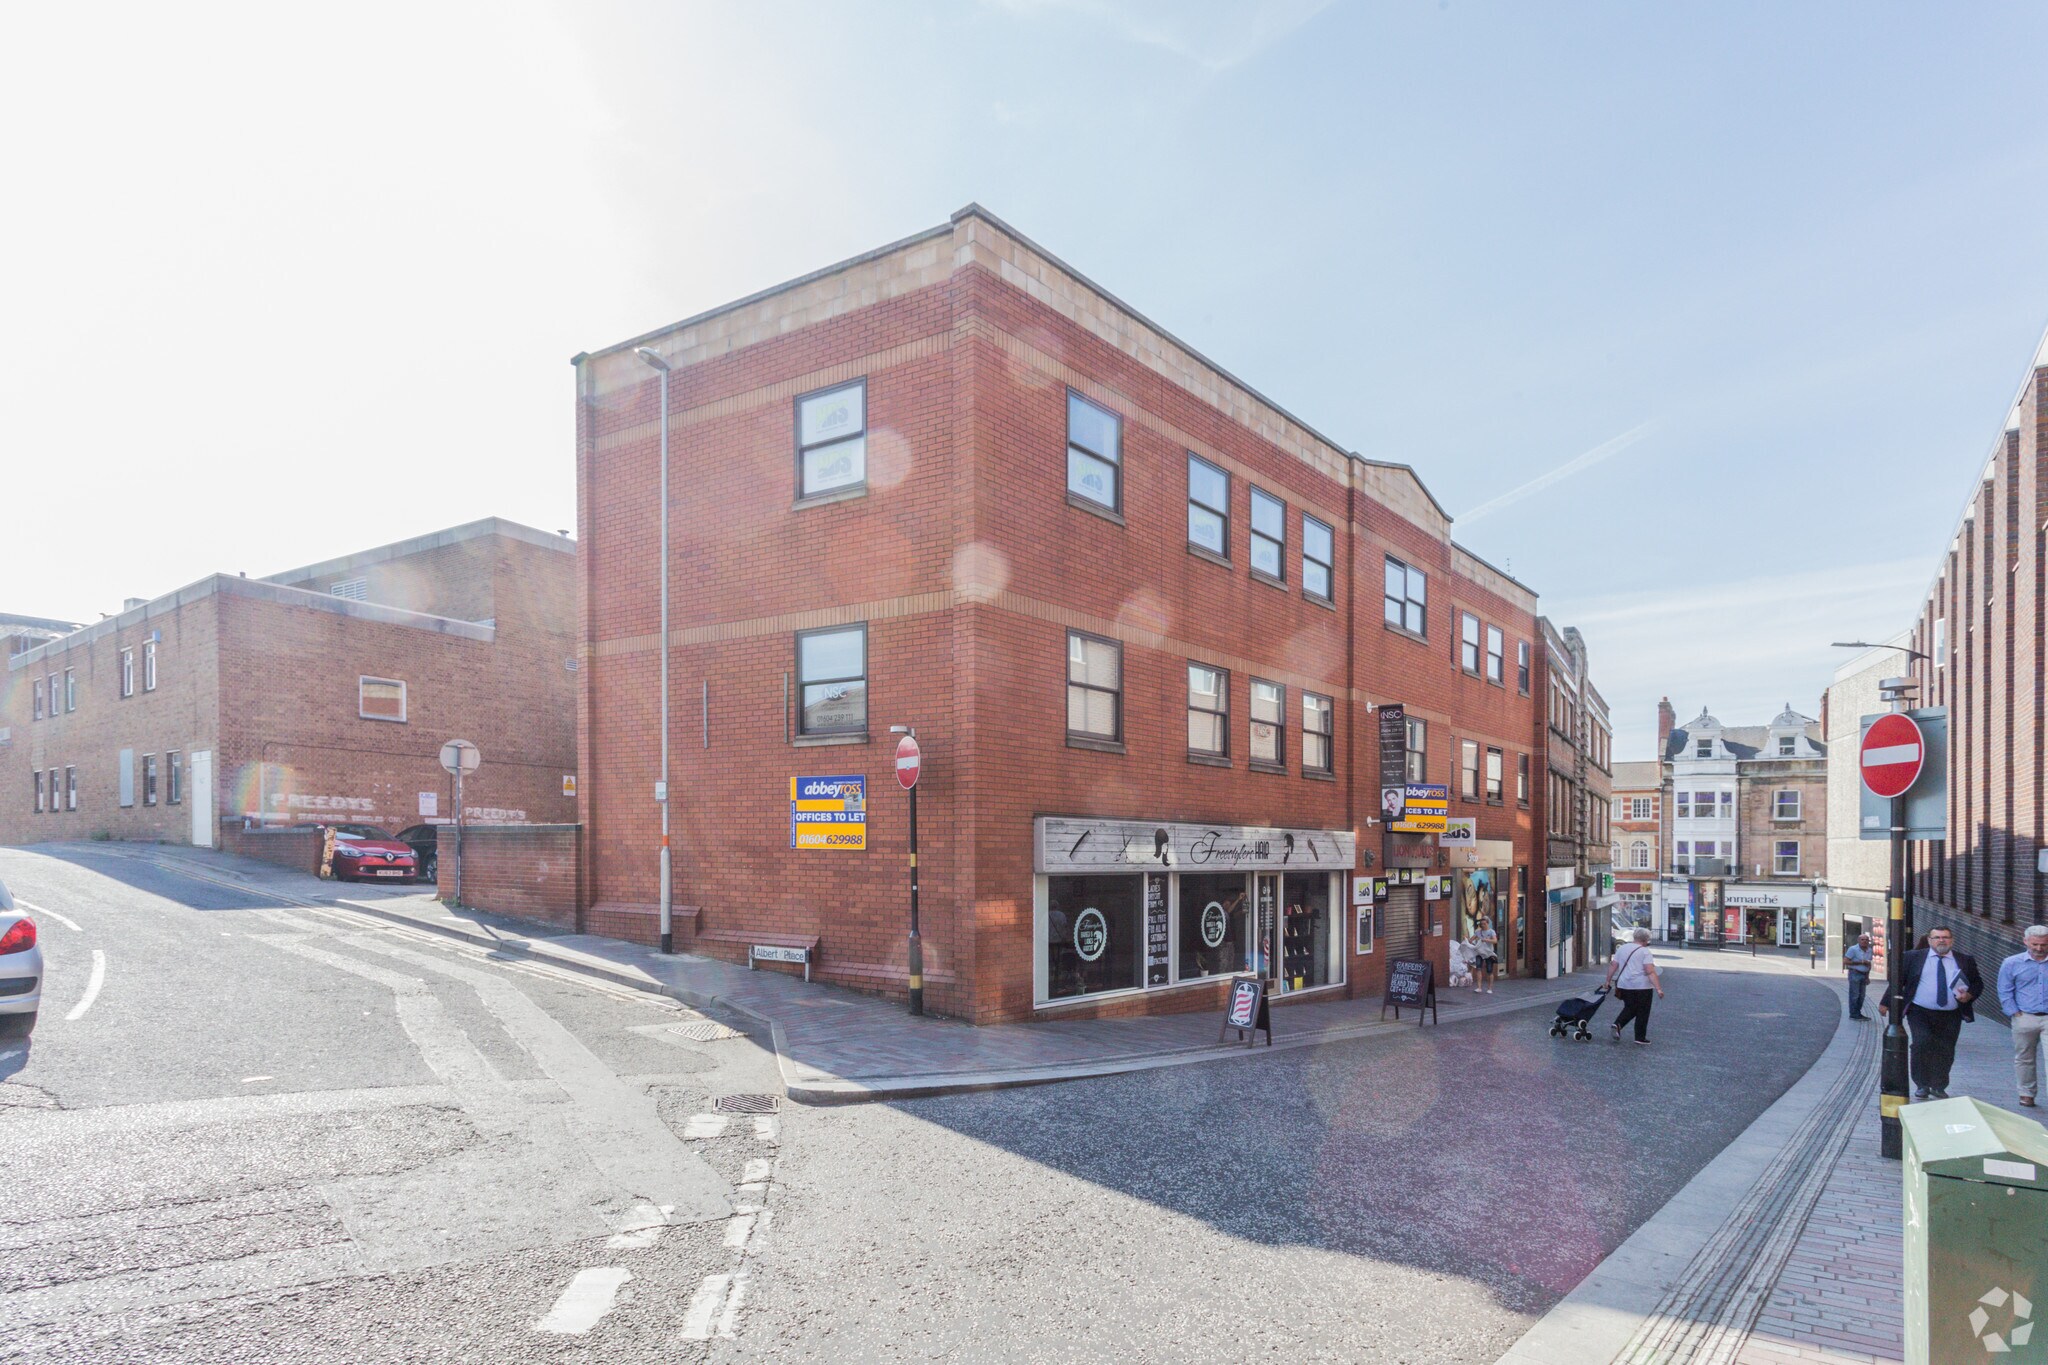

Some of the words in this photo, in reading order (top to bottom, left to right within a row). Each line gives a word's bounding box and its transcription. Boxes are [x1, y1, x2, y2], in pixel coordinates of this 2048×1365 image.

[824, 686, 847, 699] NSC
[804, 781, 862, 798] abbeyross
[1406, 787, 1445, 798] bbeyross
[795, 812, 832, 822] OFFICES
[833, 812, 847, 822] TO
[848, 812, 866, 822] LET
[1254, 841, 1270, 860] HAIR
[1724, 894, 1779, 905] onmarché
[756, 948, 778, 959] Albert
[783, 950, 804, 961] Place
